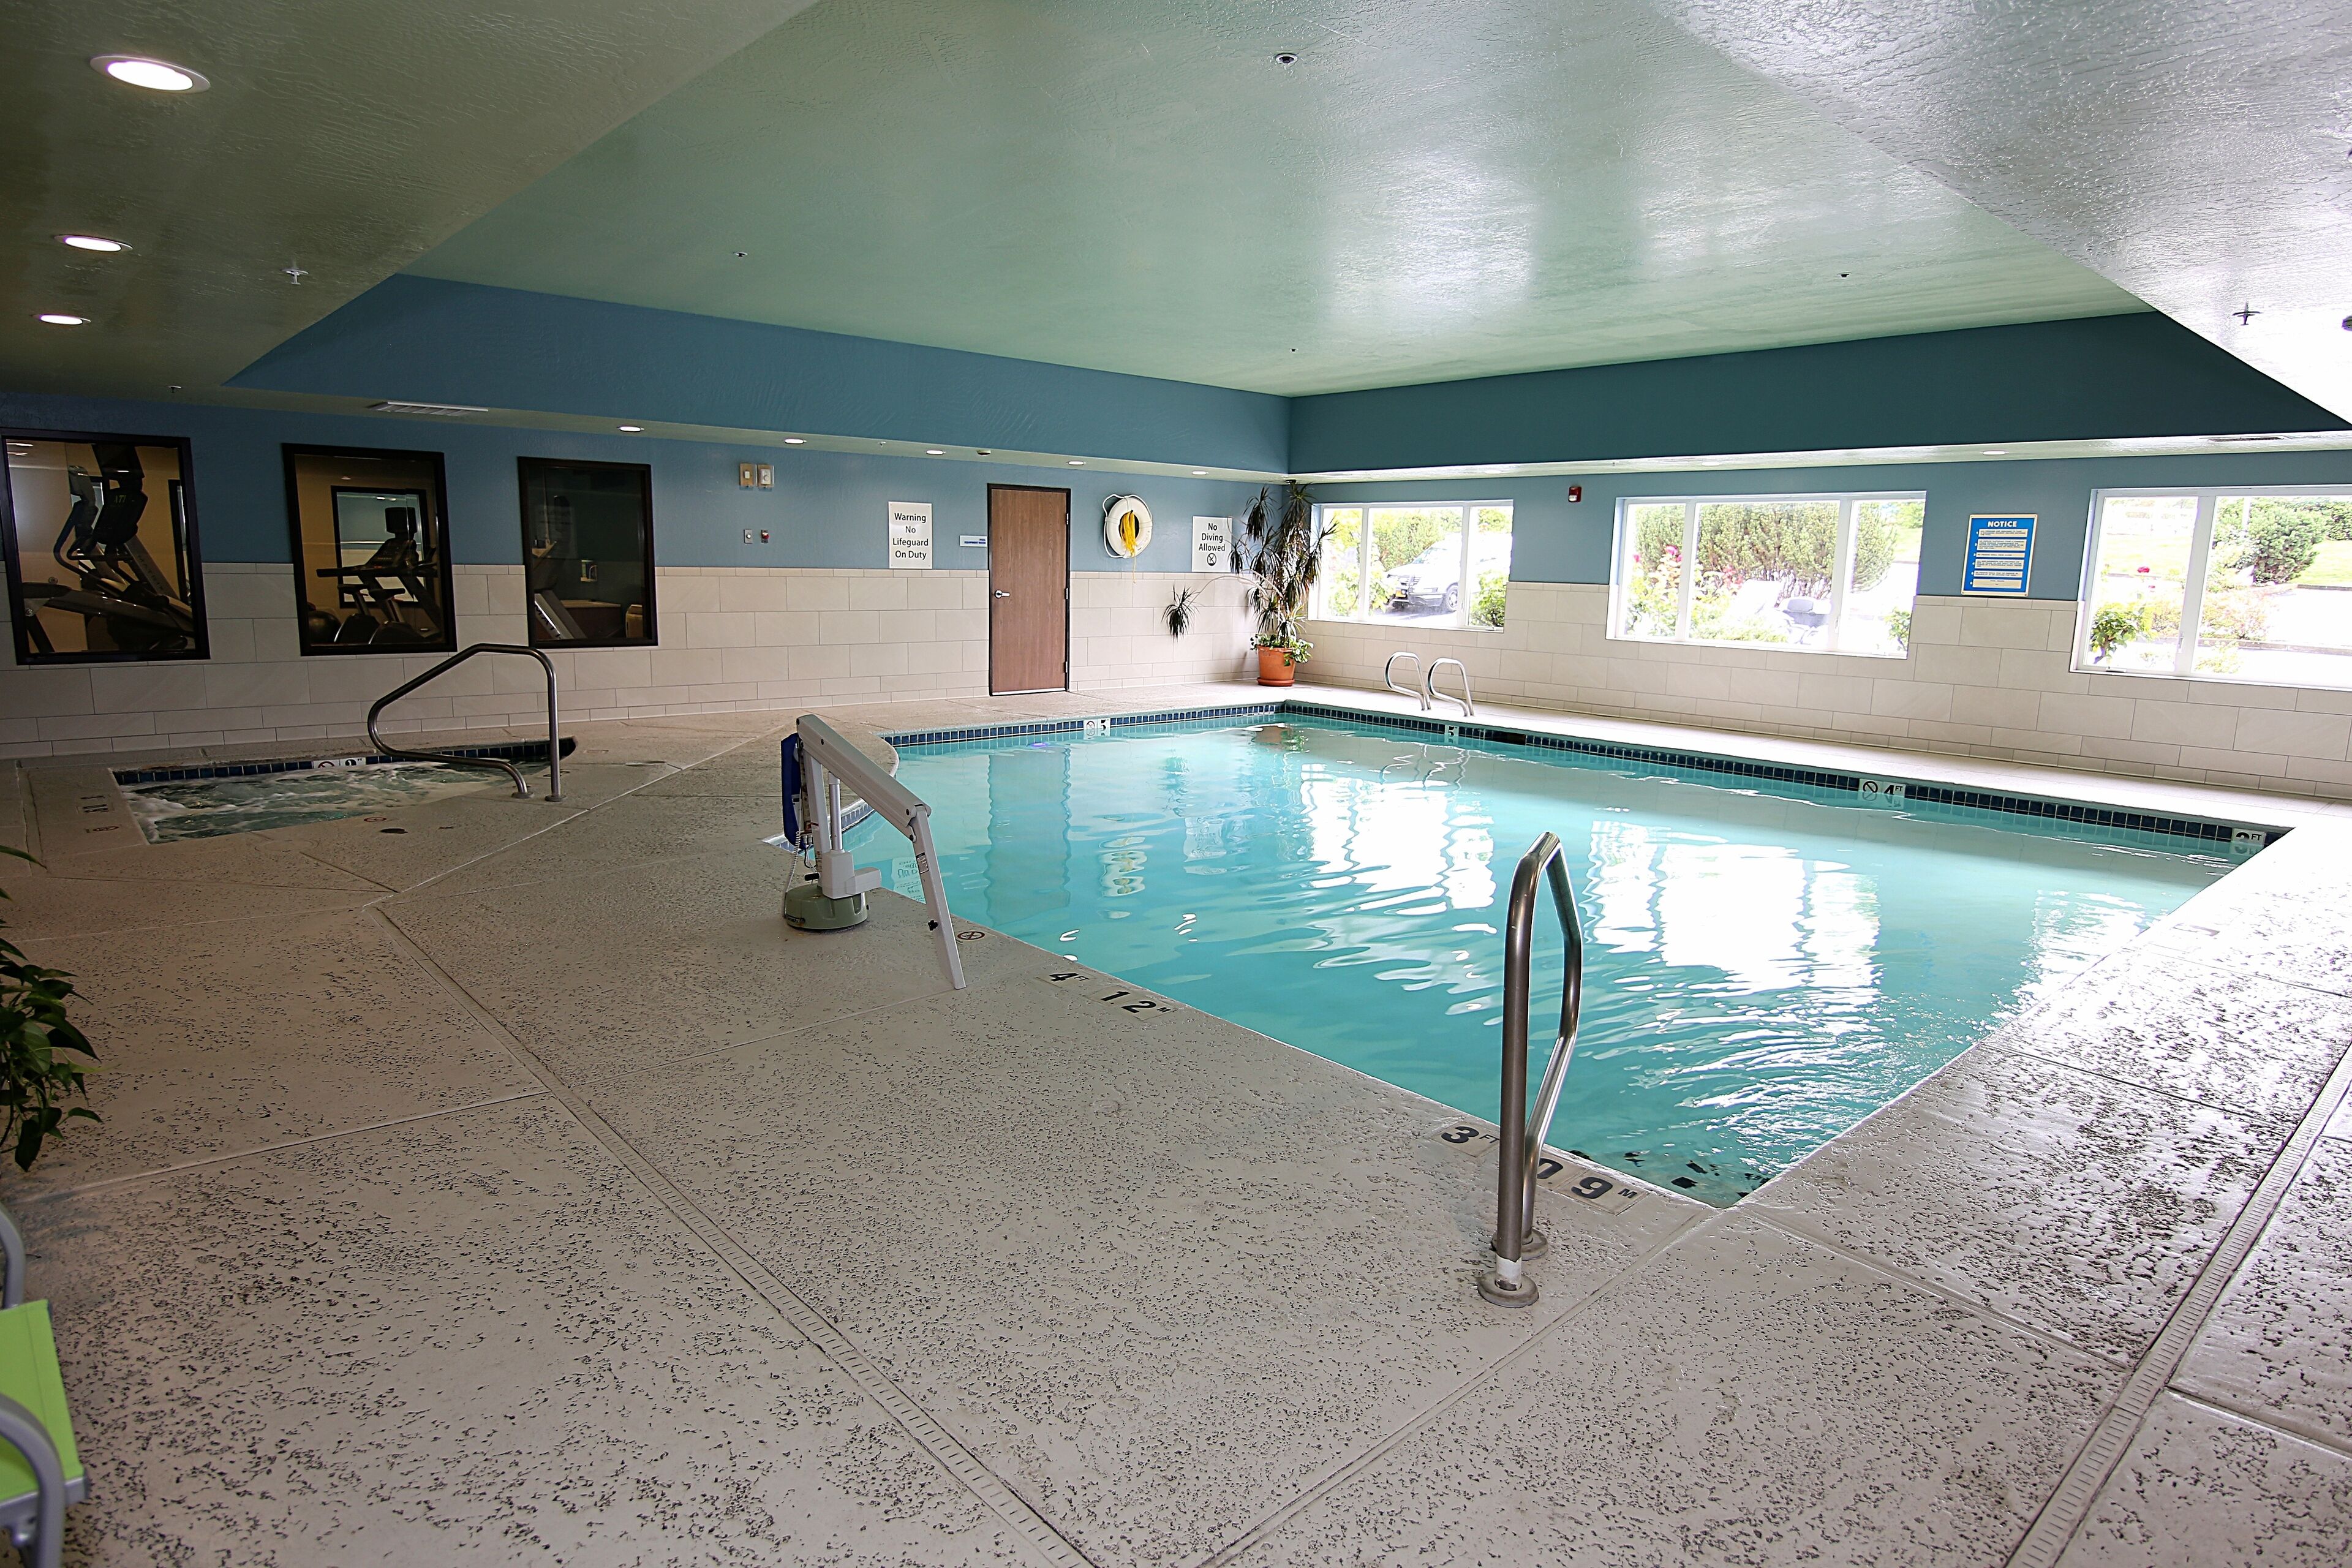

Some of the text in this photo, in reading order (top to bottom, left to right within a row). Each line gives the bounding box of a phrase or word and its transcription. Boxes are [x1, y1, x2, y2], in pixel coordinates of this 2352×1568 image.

[894, 513, 926, 523] Warning
[1208, 522, 1218, 531] No
[892, 538, 929, 548] Lifeguard
[1202, 533, 1223, 543] Diving
[1198, 543, 1226, 552] Allowed
[908, 551, 927, 560] Duty
[1101, 719, 1107, 731] 5
[1883, 785, 1894, 795] 4
[1049, 973, 1080, 982] 4
[1441, 1126, 1500, 1144] 3 FT
[1617, 1188, 1638, 1199] M
